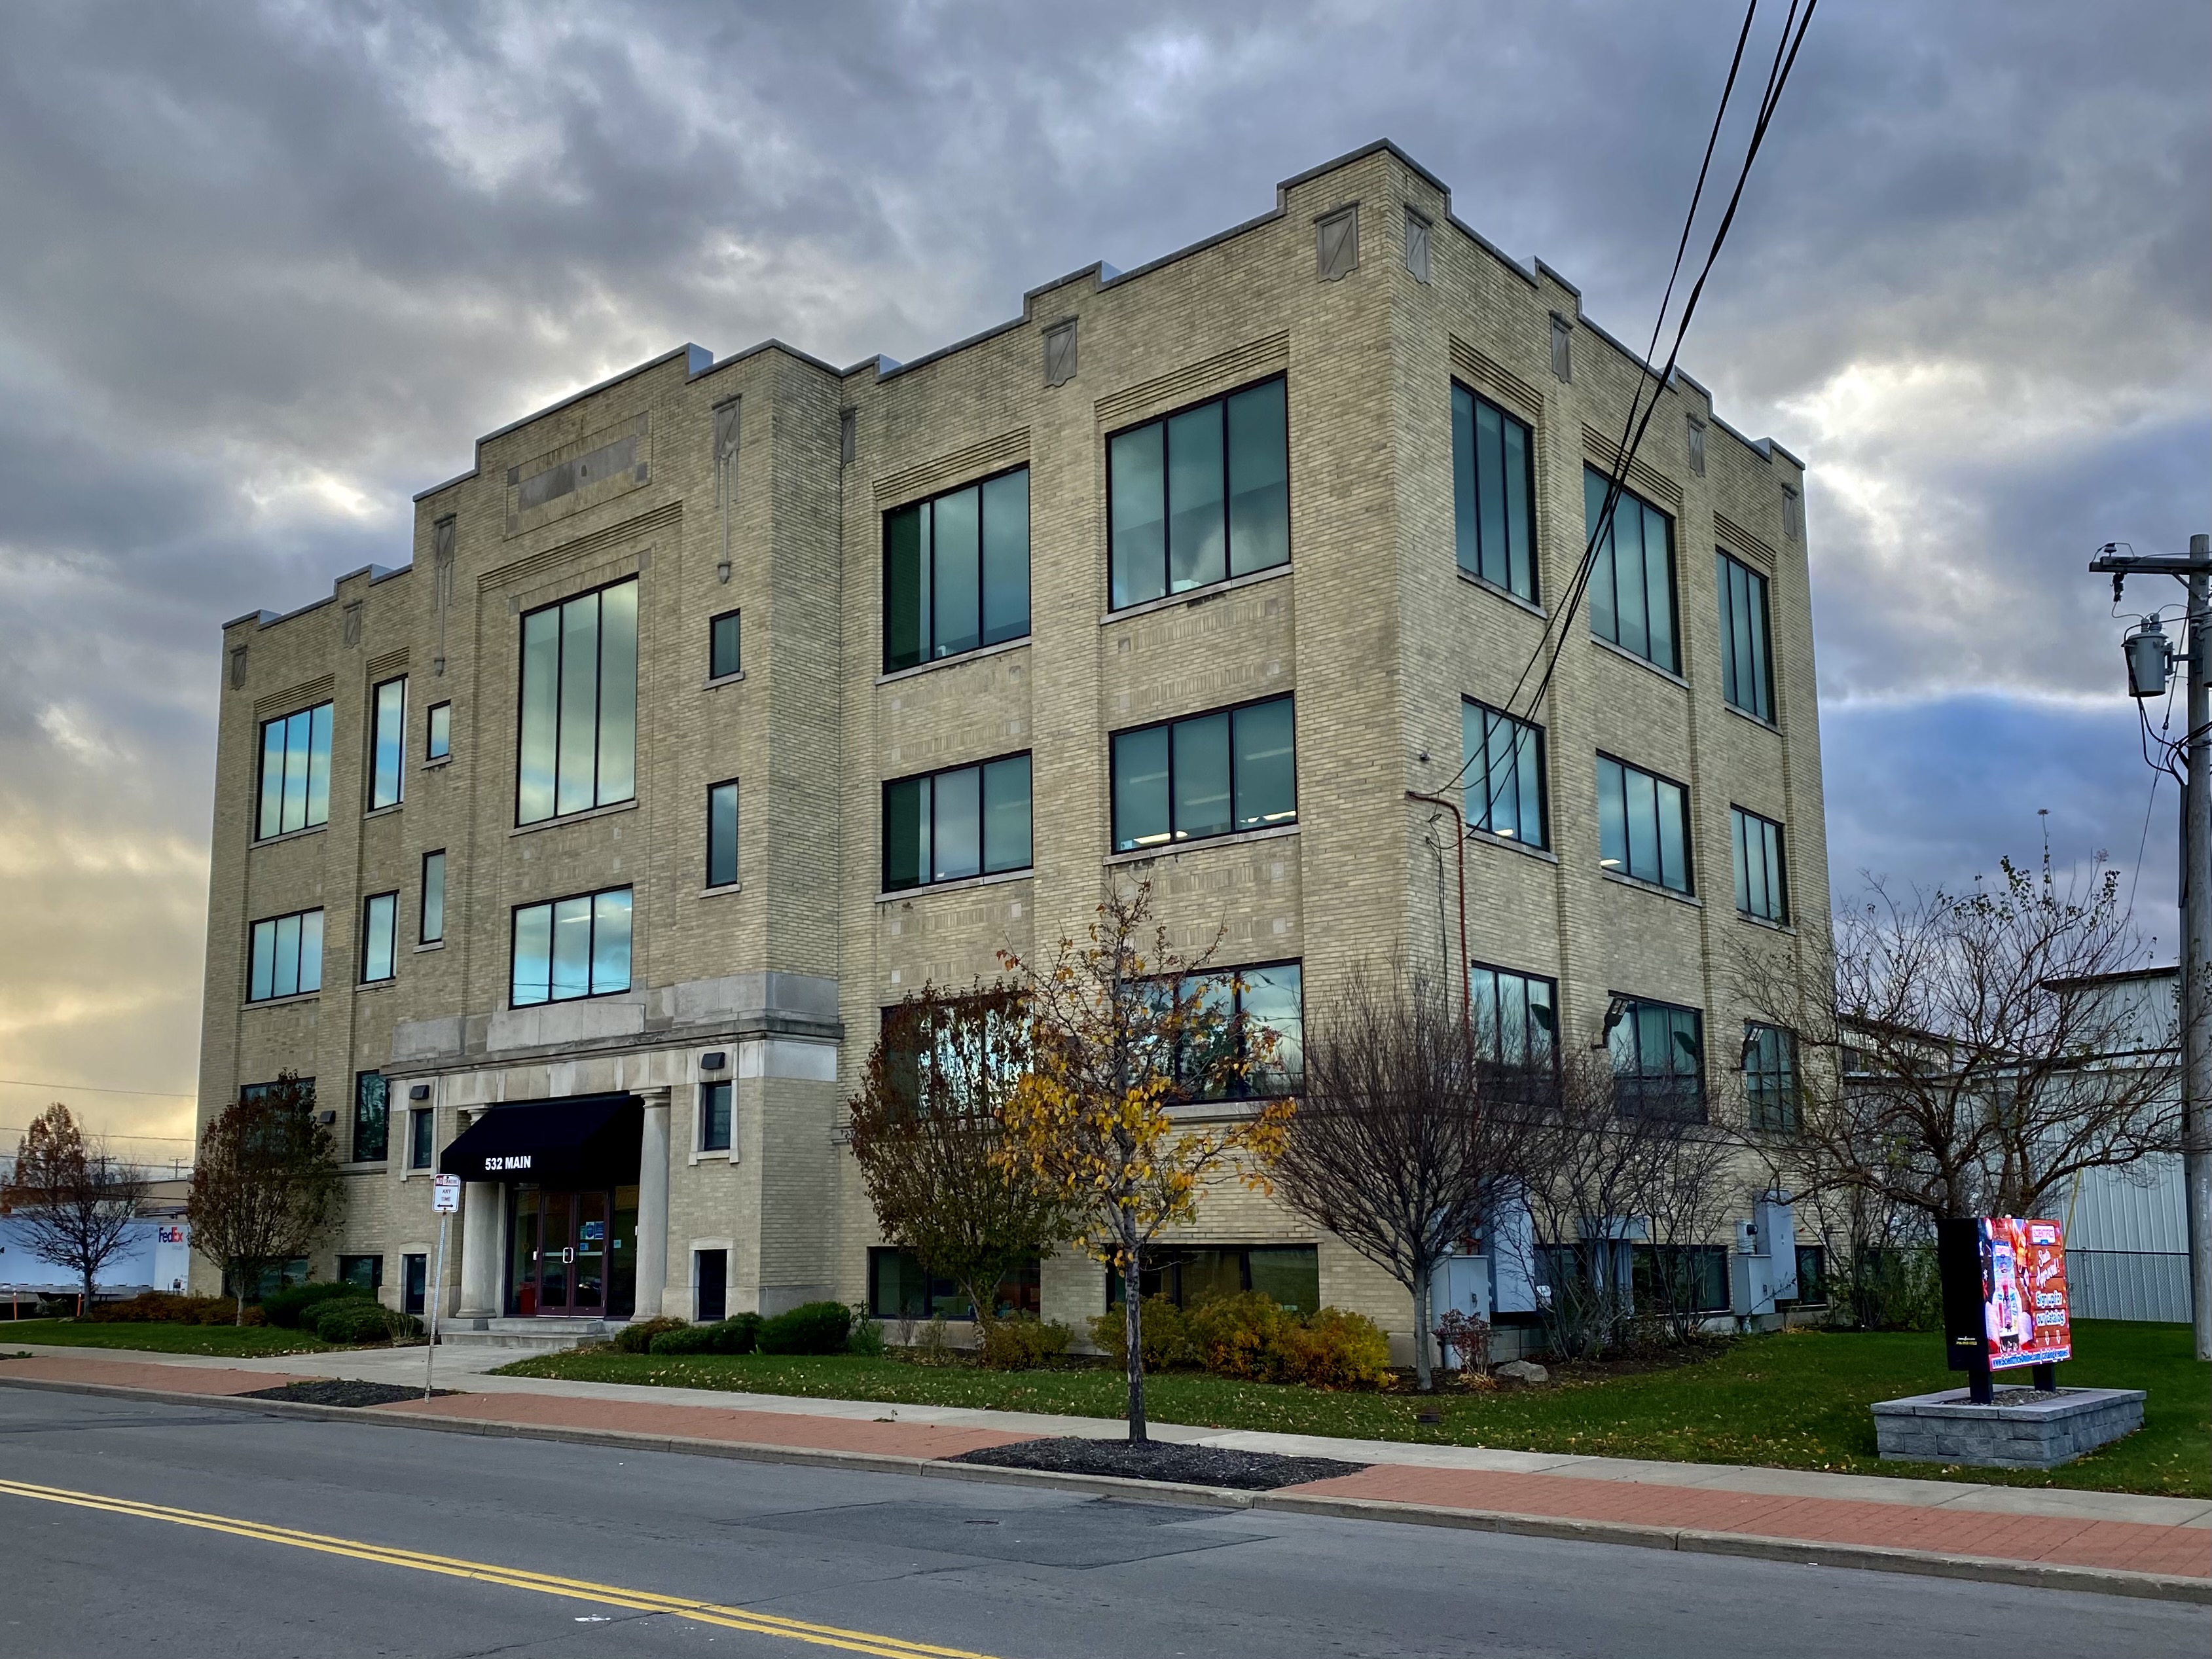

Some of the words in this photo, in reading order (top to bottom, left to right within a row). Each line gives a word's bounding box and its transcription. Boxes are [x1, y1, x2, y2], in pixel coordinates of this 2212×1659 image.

[485, 1158, 503, 1170] 532
[505, 1156, 531, 1169] MAIN
[158, 1226, 183, 1243] FedEx
